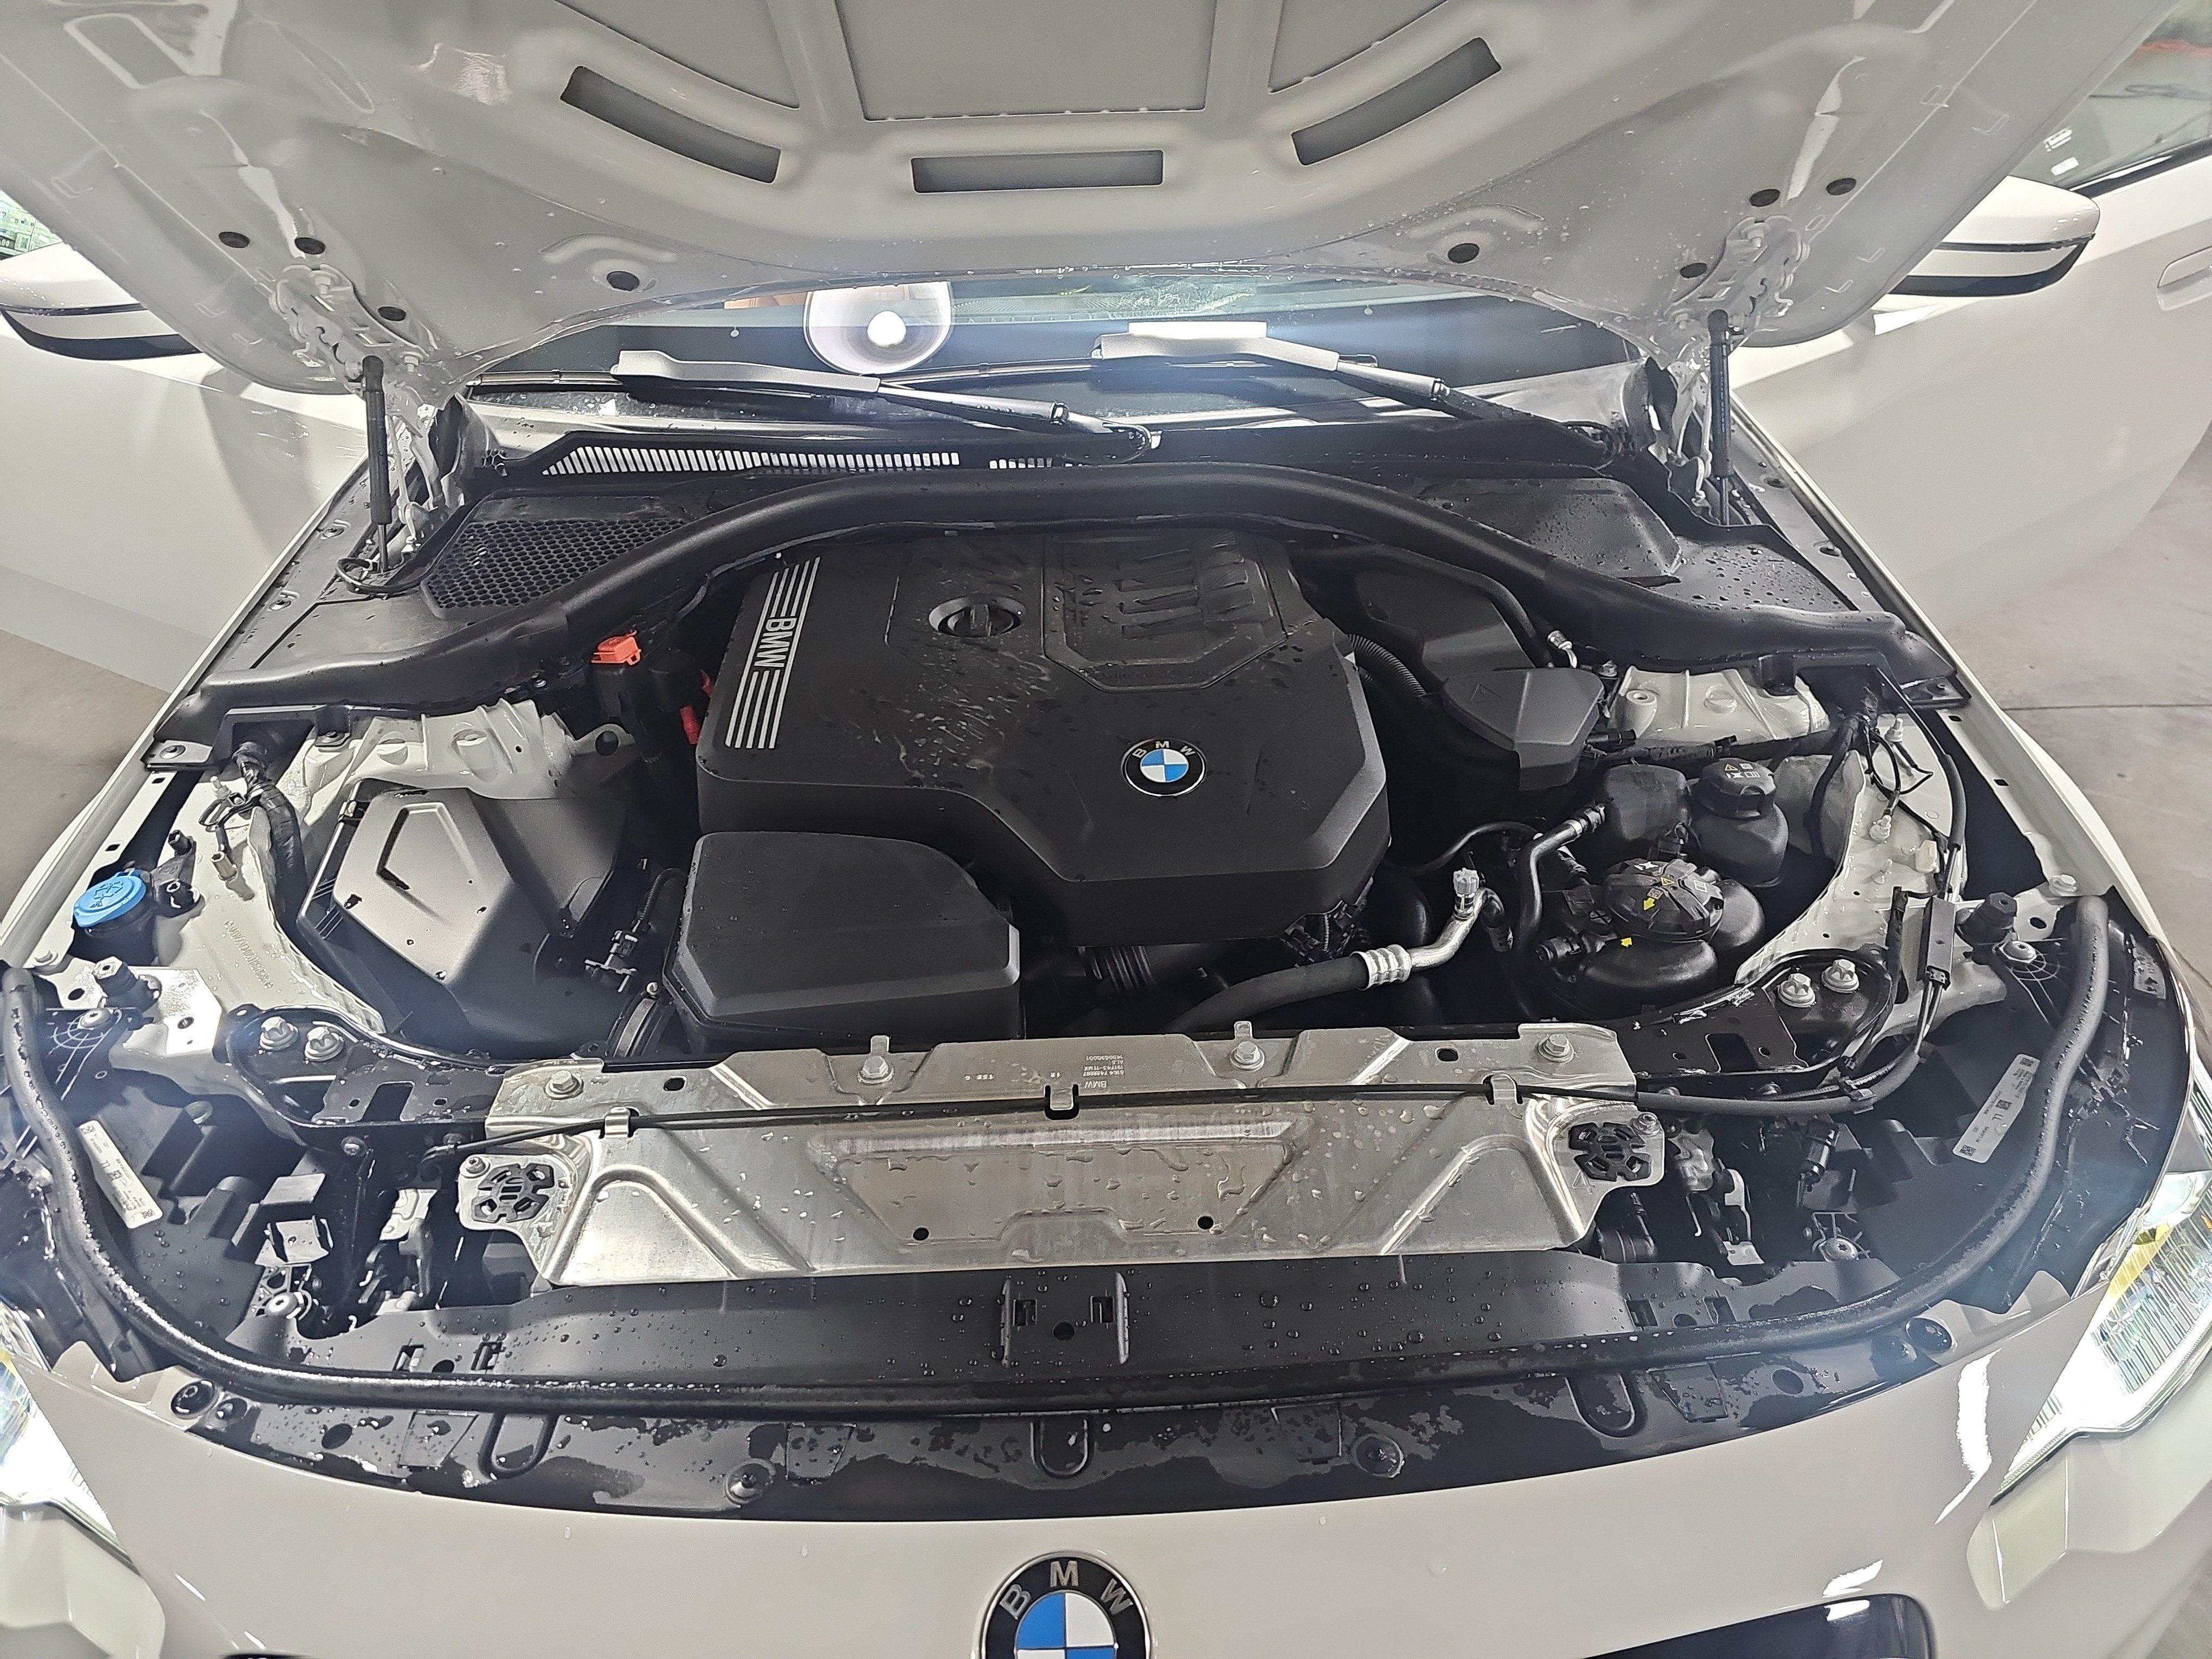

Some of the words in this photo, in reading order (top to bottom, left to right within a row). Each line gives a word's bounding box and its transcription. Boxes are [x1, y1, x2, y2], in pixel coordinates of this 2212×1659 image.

[754, 617, 797, 668] BMW
[1131, 740, 1196, 758] BMW
[1084, 1081, 1107, 1089] BMW
[999, 1560, 1134, 1620] BMW
